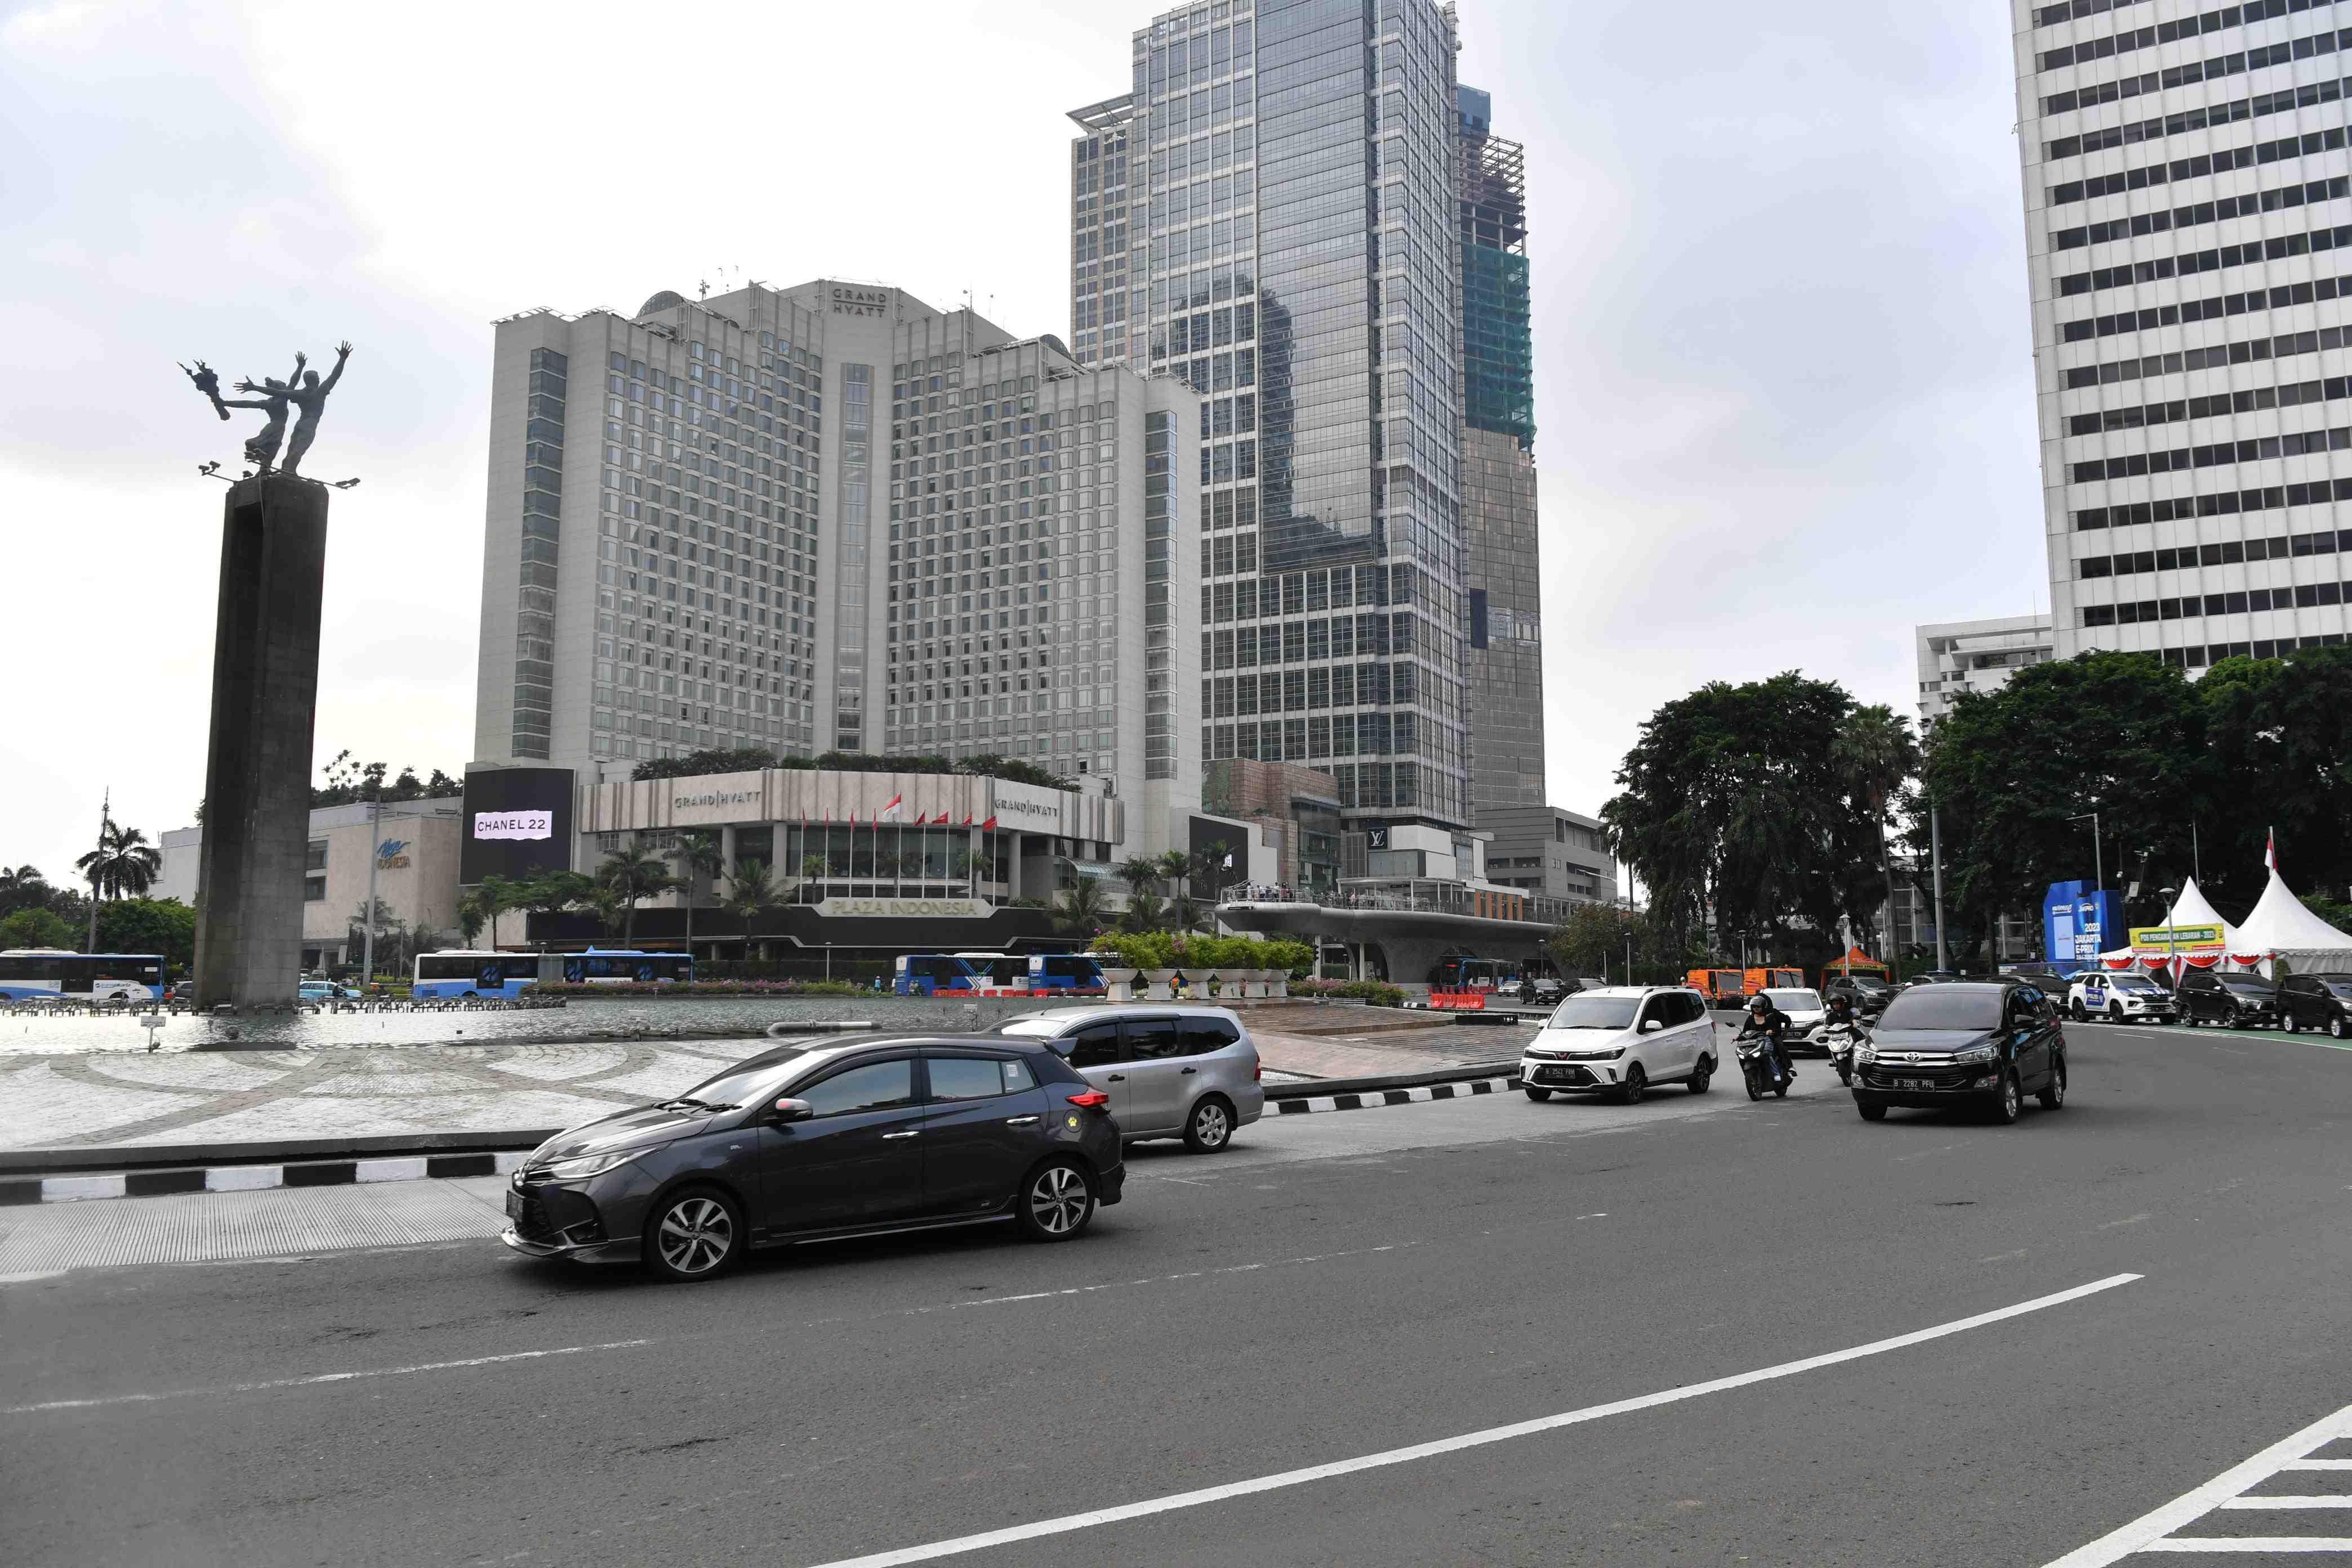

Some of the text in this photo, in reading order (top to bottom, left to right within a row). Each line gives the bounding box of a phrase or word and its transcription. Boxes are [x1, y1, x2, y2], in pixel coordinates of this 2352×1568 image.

[834, 288, 887, 303] GRAND
[834, 304, 885, 318] HYATT
[675, 791, 761, 808] GRAND HYATT
[995, 799, 1058, 817] GRAND HYATT
[478, 819, 545, 832] CHANEL 22
[832, 901, 978, 915] PLAZA INDONESIA
[2084, 923, 2100, 932] 2023
[2075, 934, 2102, 944] JAKARTA
[2075, 944, 2094, 954] E-PRIX
